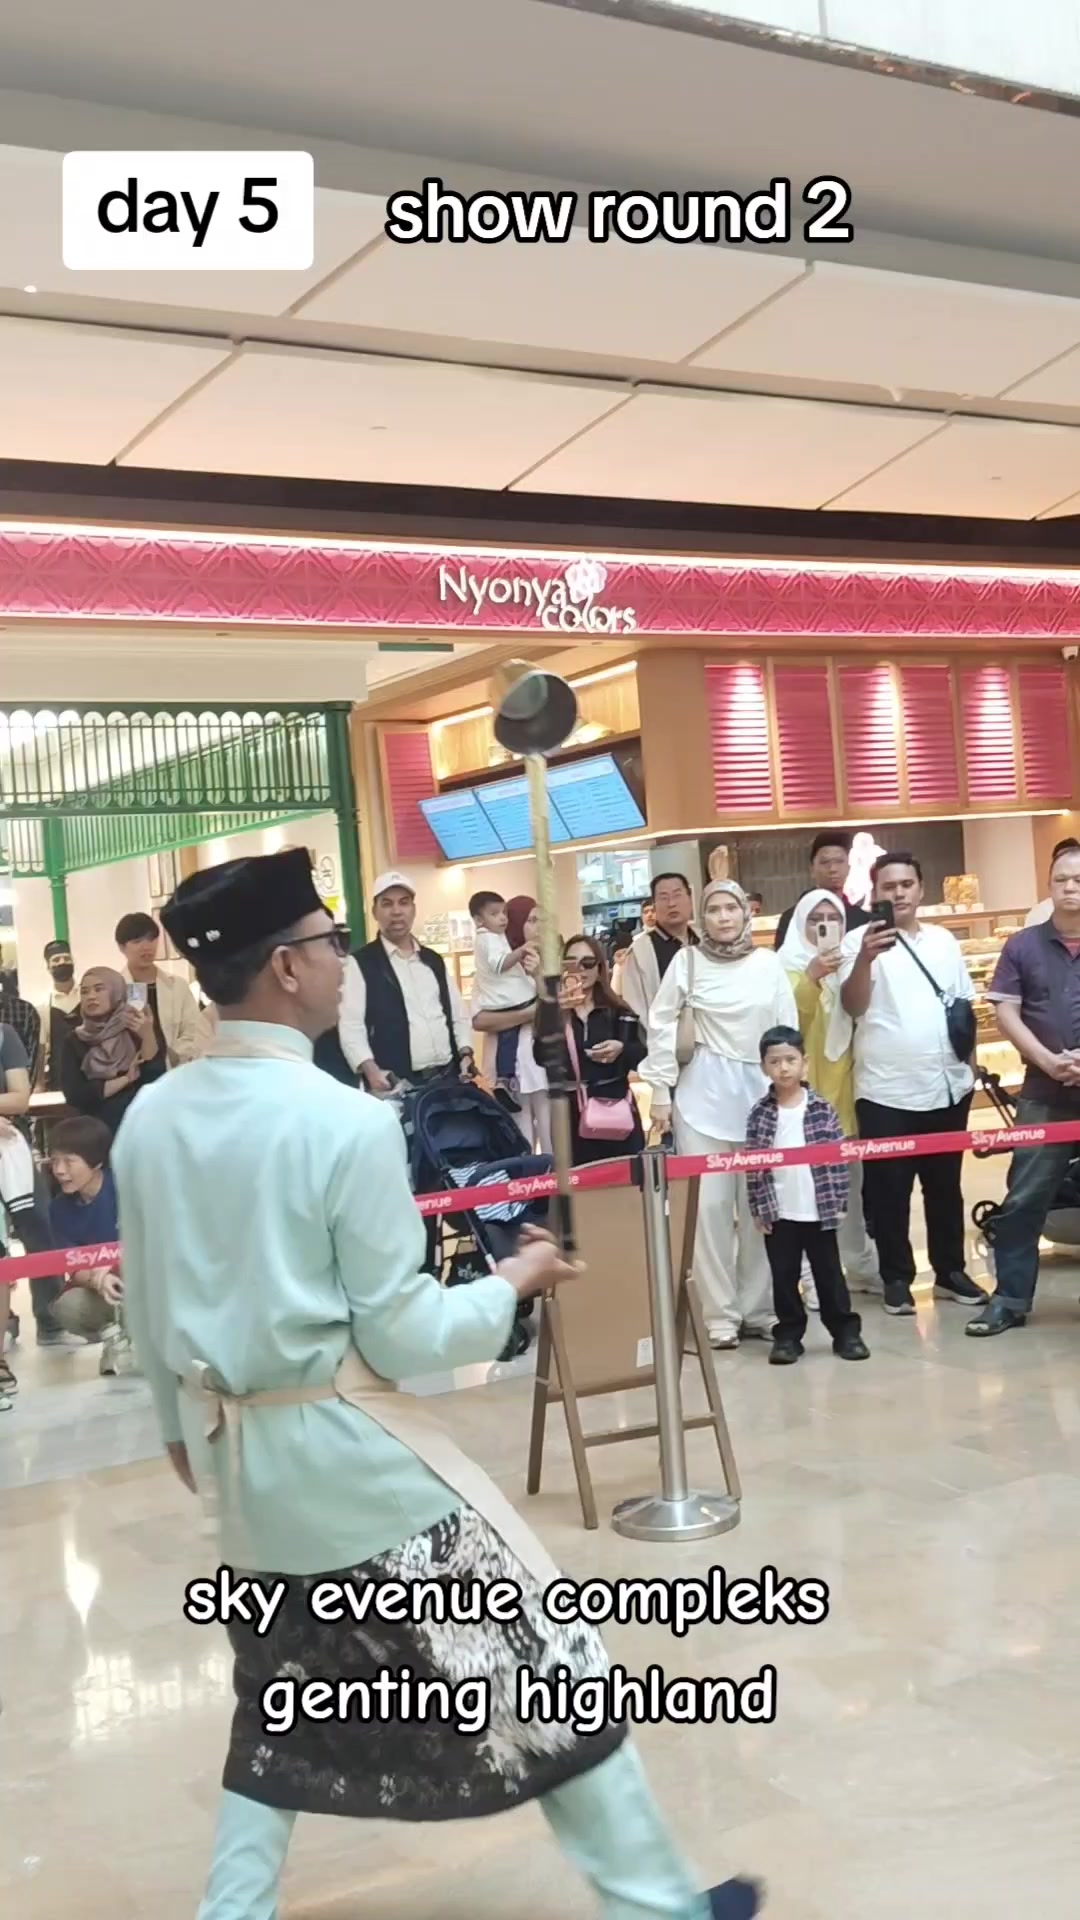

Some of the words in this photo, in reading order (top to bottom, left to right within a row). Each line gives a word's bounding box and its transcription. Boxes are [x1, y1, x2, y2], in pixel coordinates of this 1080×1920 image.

[439, 563, 567, 617] Nyonya
[970, 1127, 1047, 1148] SkyAvenue
[840, 1138, 916, 1158] SkyAvenue
[705, 1150, 784, 1170] SkyAvenue
